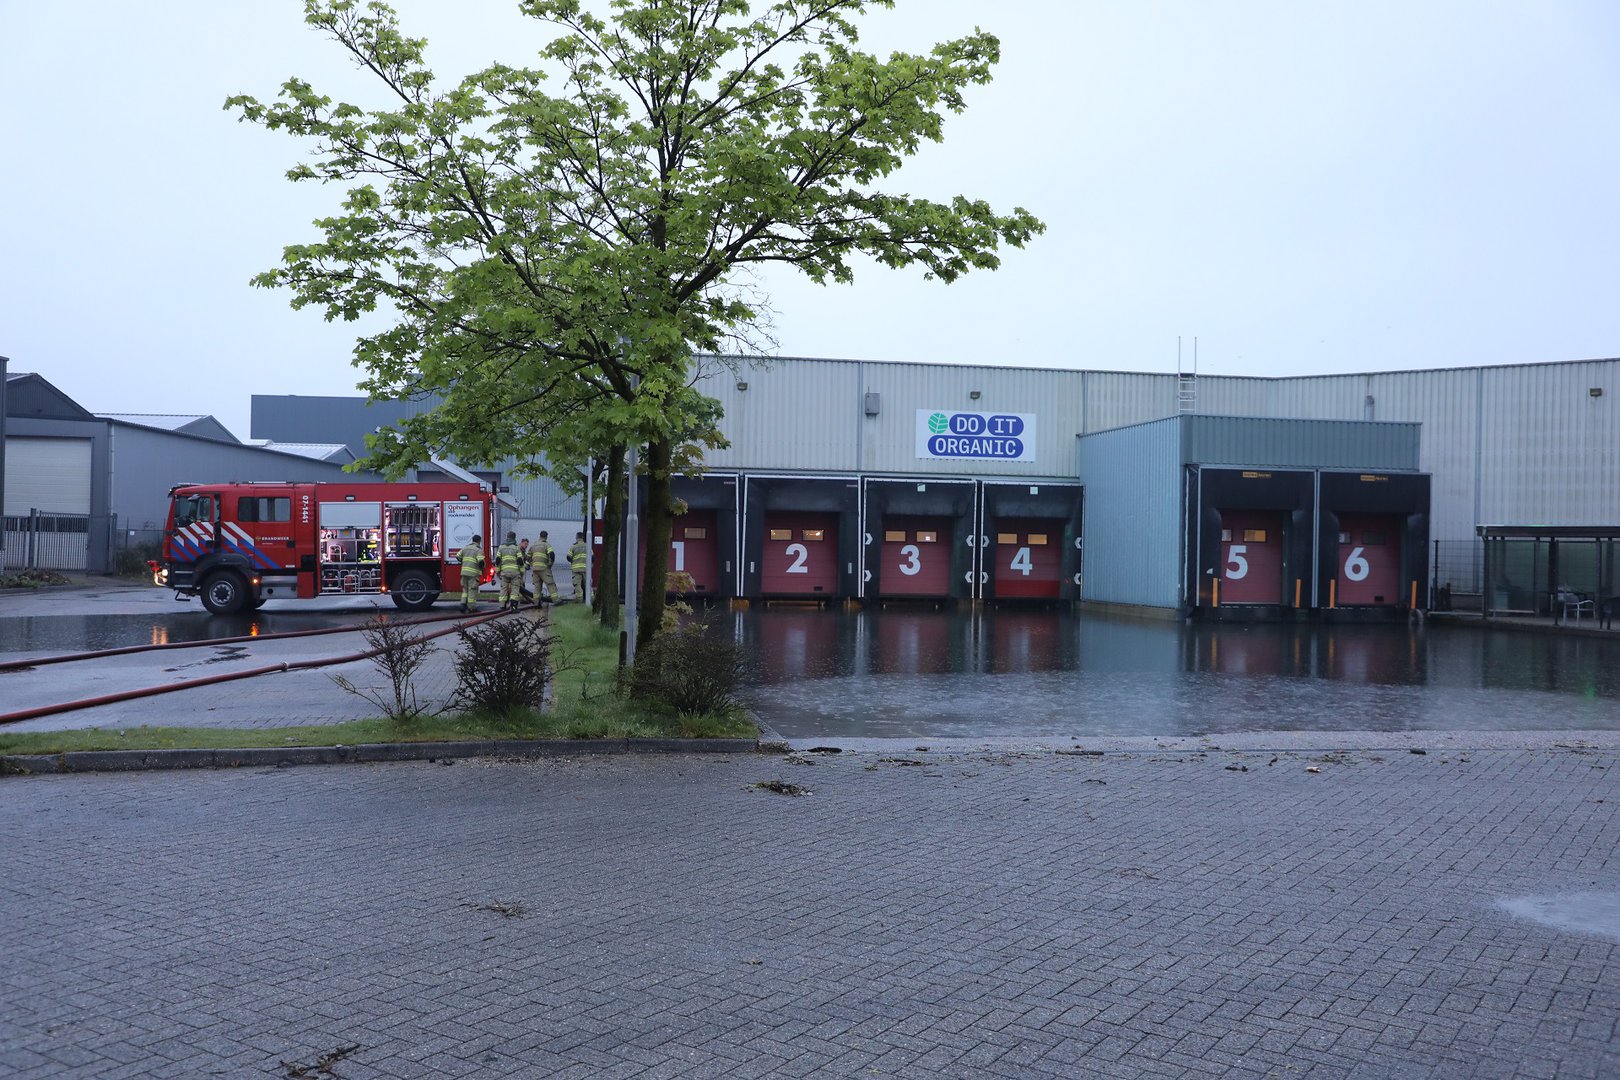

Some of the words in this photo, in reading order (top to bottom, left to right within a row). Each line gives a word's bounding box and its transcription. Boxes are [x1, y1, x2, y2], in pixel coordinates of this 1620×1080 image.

[956, 416, 979, 433] DO
[994, 418, 1017, 434] IT
[935, 437, 1016, 456] ORGANIC
[672, 541, 685, 571] 1
[785, 543, 808, 573] 2
[899, 544, 922, 576] 3
[1010, 547, 1033, 576] 4
[1225, 545, 1249, 580] 5
[1344, 547, 1370, 582] 6
